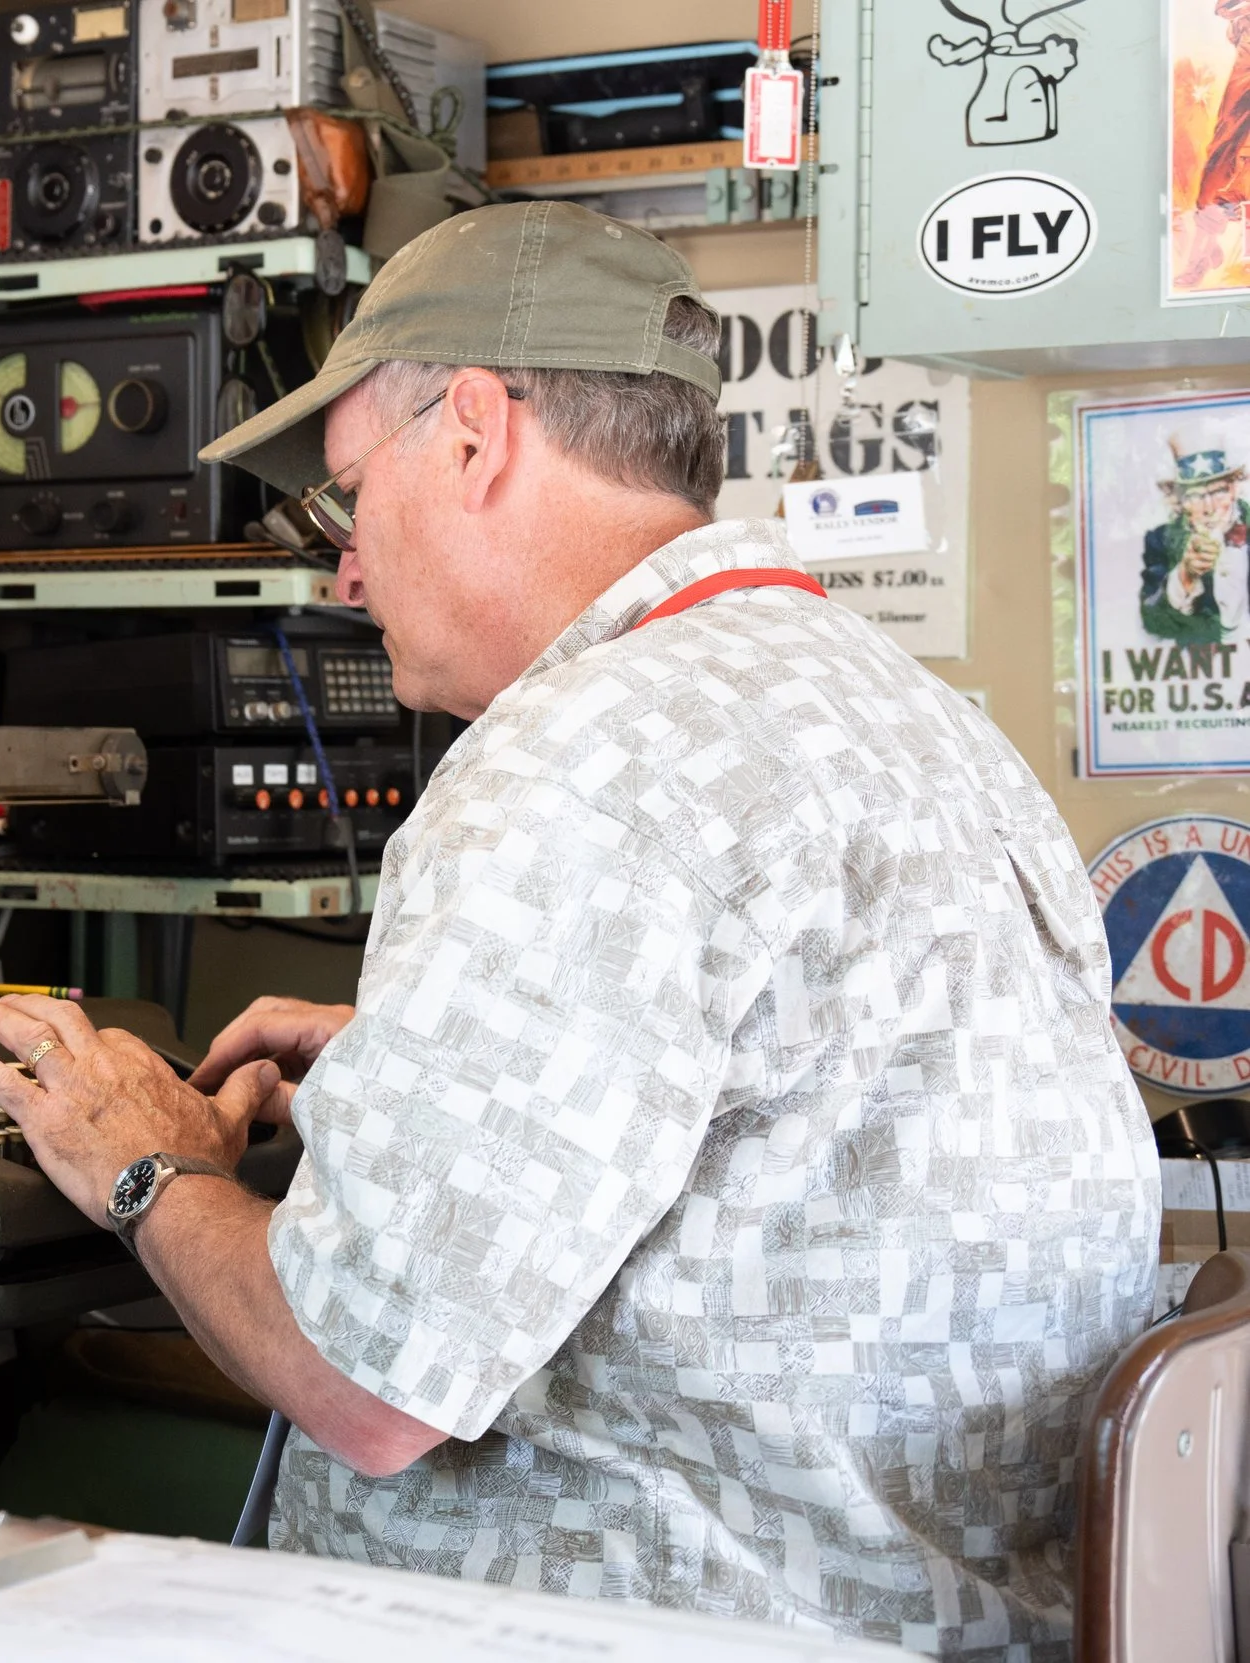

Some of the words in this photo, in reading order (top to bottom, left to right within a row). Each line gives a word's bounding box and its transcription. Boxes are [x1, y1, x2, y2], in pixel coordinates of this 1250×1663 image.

[937, 220, 948, 262] I
[972, 210, 1074, 259] FLY
[968, 272, 1040, 286] avemco.com
[726, 399, 940, 480] TAGS
[815, 520, 849, 531] RALLY
[853, 515, 899, 527] VENDOR
[873, 570, 927, 587] $7.00
[1103, 650, 1112, 684] I
[1125, 643, 1237, 682] WANT
[1104, 687, 1155, 715] FOR
[1112, 720, 1169, 732] NEAREST
[1142, 829, 1168, 857] IS
[1186, 824, 1203, 848] A
[1152, 909, 1245, 1002] CD
[1129, 1045, 1206, 1087] CIVIL
